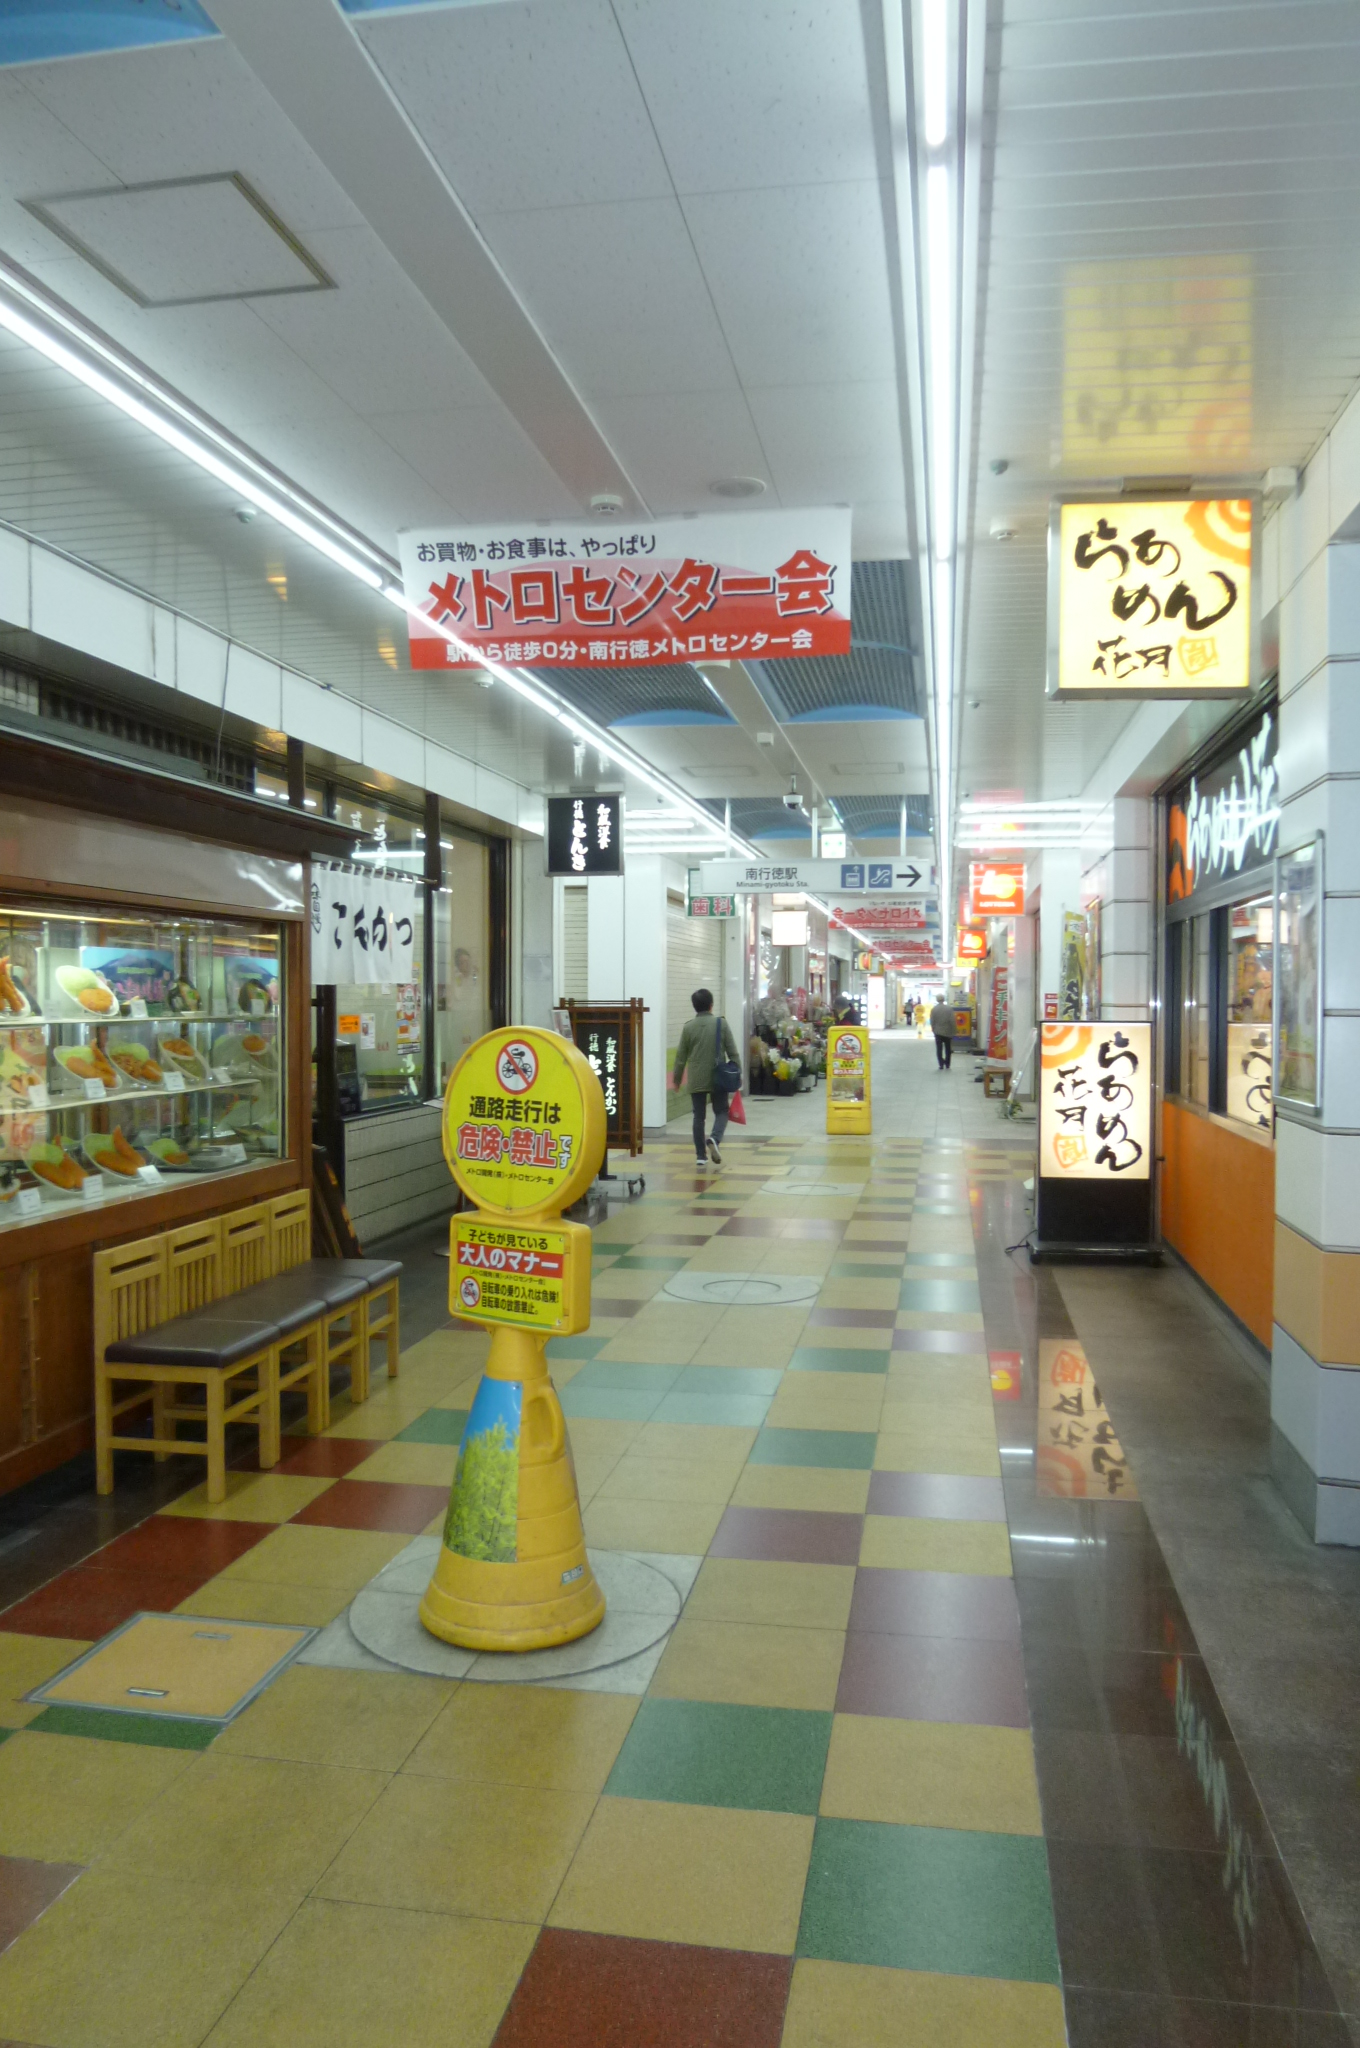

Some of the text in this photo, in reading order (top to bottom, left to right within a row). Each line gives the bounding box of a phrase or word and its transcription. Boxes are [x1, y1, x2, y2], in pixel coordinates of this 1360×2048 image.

[424, 549, 836, 630] メトロセンター会
[1112, 570, 1237, 631] めん
[1092, 636, 1172, 679] 花月
[736, 880, 795, 889] Minami-gyotoku
[745, 867, 798, 880] 南行徳駅
[691, 897, 733, 916] 歯科
[469, 1095, 561, 1124] 通路走行は
[605, 1077, 617, 1115] とんかつ
[1053, 1066, 1093, 1131] 花月
[1095, 1031, 1142, 1172] らあめん
[458, 1122, 557, 1168] 危険・禁止
[460, 1243, 559, 1273] 大人のマナー
[468, 1229, 548, 1250] 子どもが見ている
